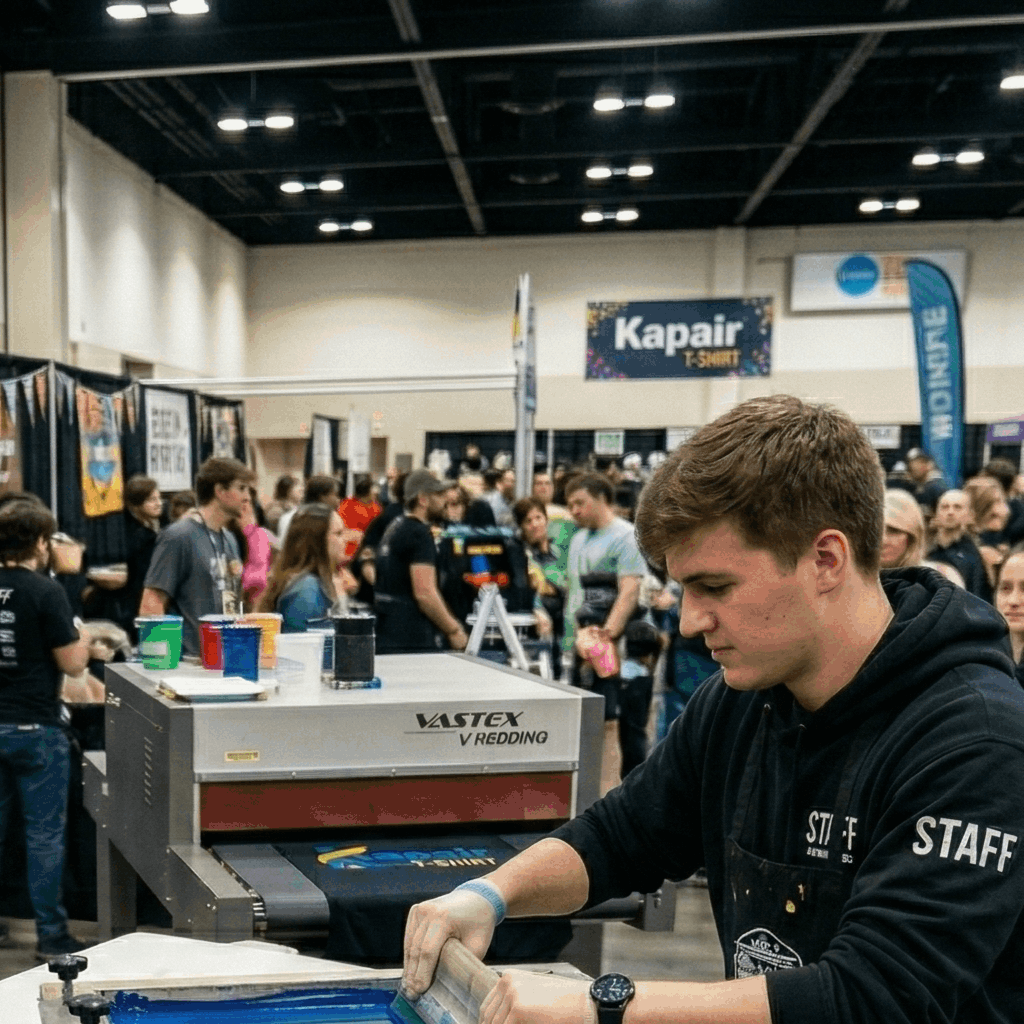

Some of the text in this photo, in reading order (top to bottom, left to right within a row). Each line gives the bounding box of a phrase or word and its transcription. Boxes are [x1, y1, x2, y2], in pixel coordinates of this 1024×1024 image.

[615, 313, 744, 357] Kapair
[684, 350, 741, 367] T-SHIRT
[416, 711, 524, 729] VASTEX
[459, 730, 549, 747] V REDDING
[806, 810, 858, 851] STF
[912, 815, 1018, 873] STAFF
[410, 857, 496, 868] T-SHIRT
